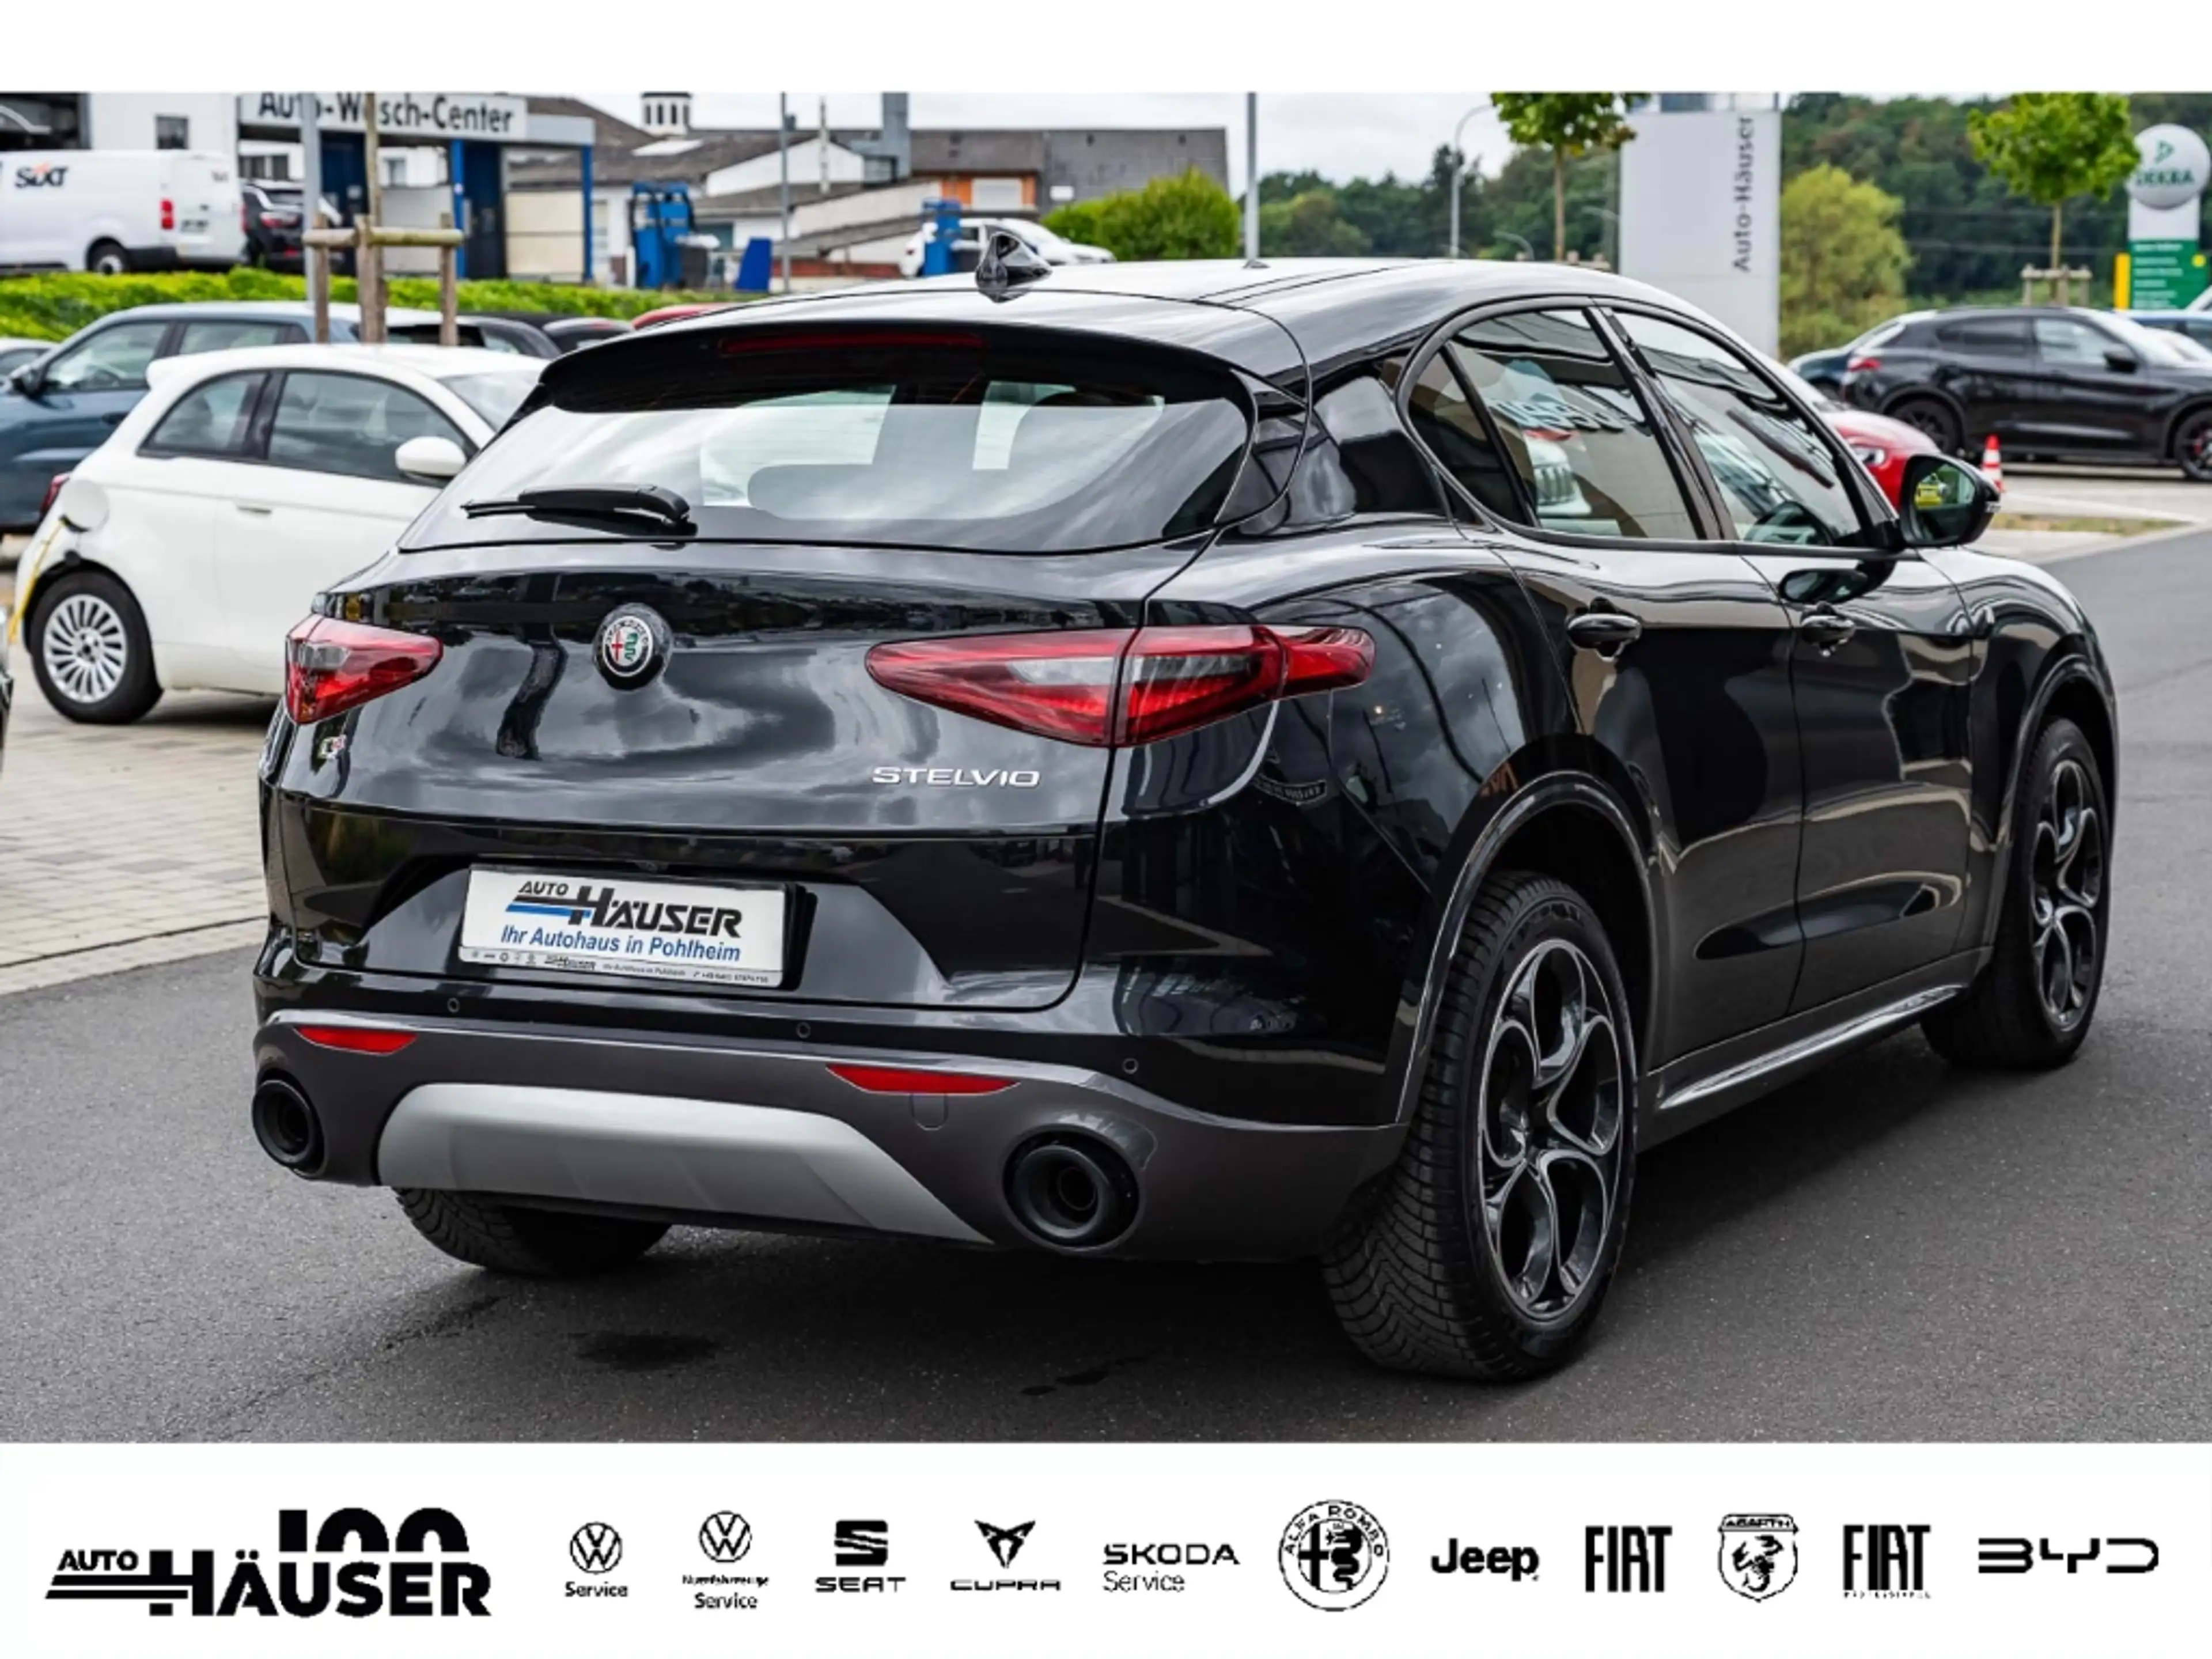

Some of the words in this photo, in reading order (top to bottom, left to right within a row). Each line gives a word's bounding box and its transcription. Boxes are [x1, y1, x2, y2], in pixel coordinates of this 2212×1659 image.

[1732, 116, 1754, 272] Auto-Häuser
[872, 766, 1040, 787] STELVIO
[518, 880, 569, 896] AUTO
[567, 885, 743, 939] HÄUSER
[501, 925, 528, 945] Ihr
[529, 927, 620, 953] Autohaus
[625, 934, 644, 955] in
[648, 940, 741, 962] Pohlheim
